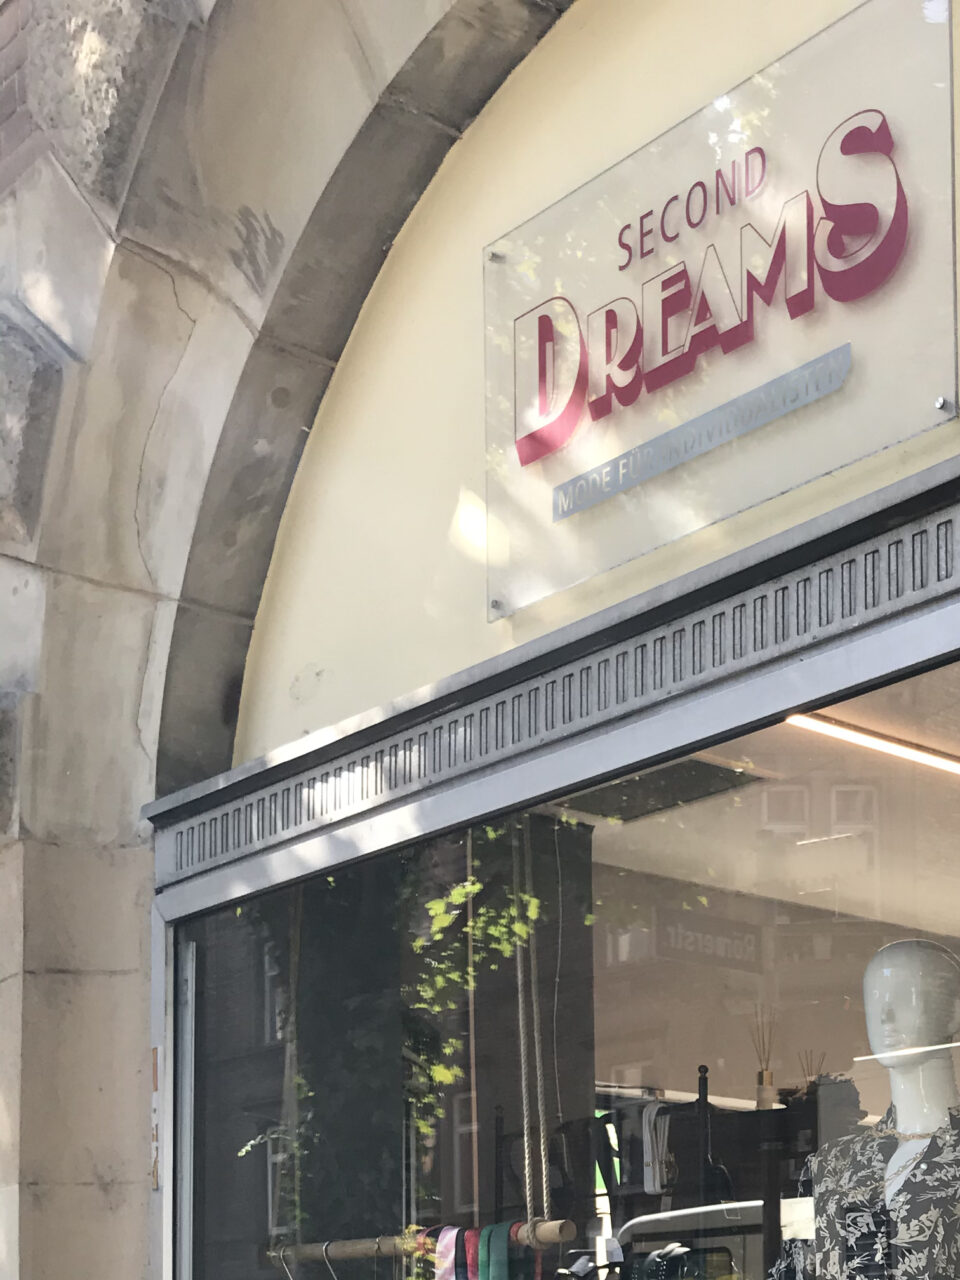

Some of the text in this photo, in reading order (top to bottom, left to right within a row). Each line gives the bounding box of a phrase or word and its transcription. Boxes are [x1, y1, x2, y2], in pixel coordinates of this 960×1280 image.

[618, 146, 766, 271] SECOND
[514, 108, 909, 467] DREAMS
[558, 465, 611, 515] MODE
